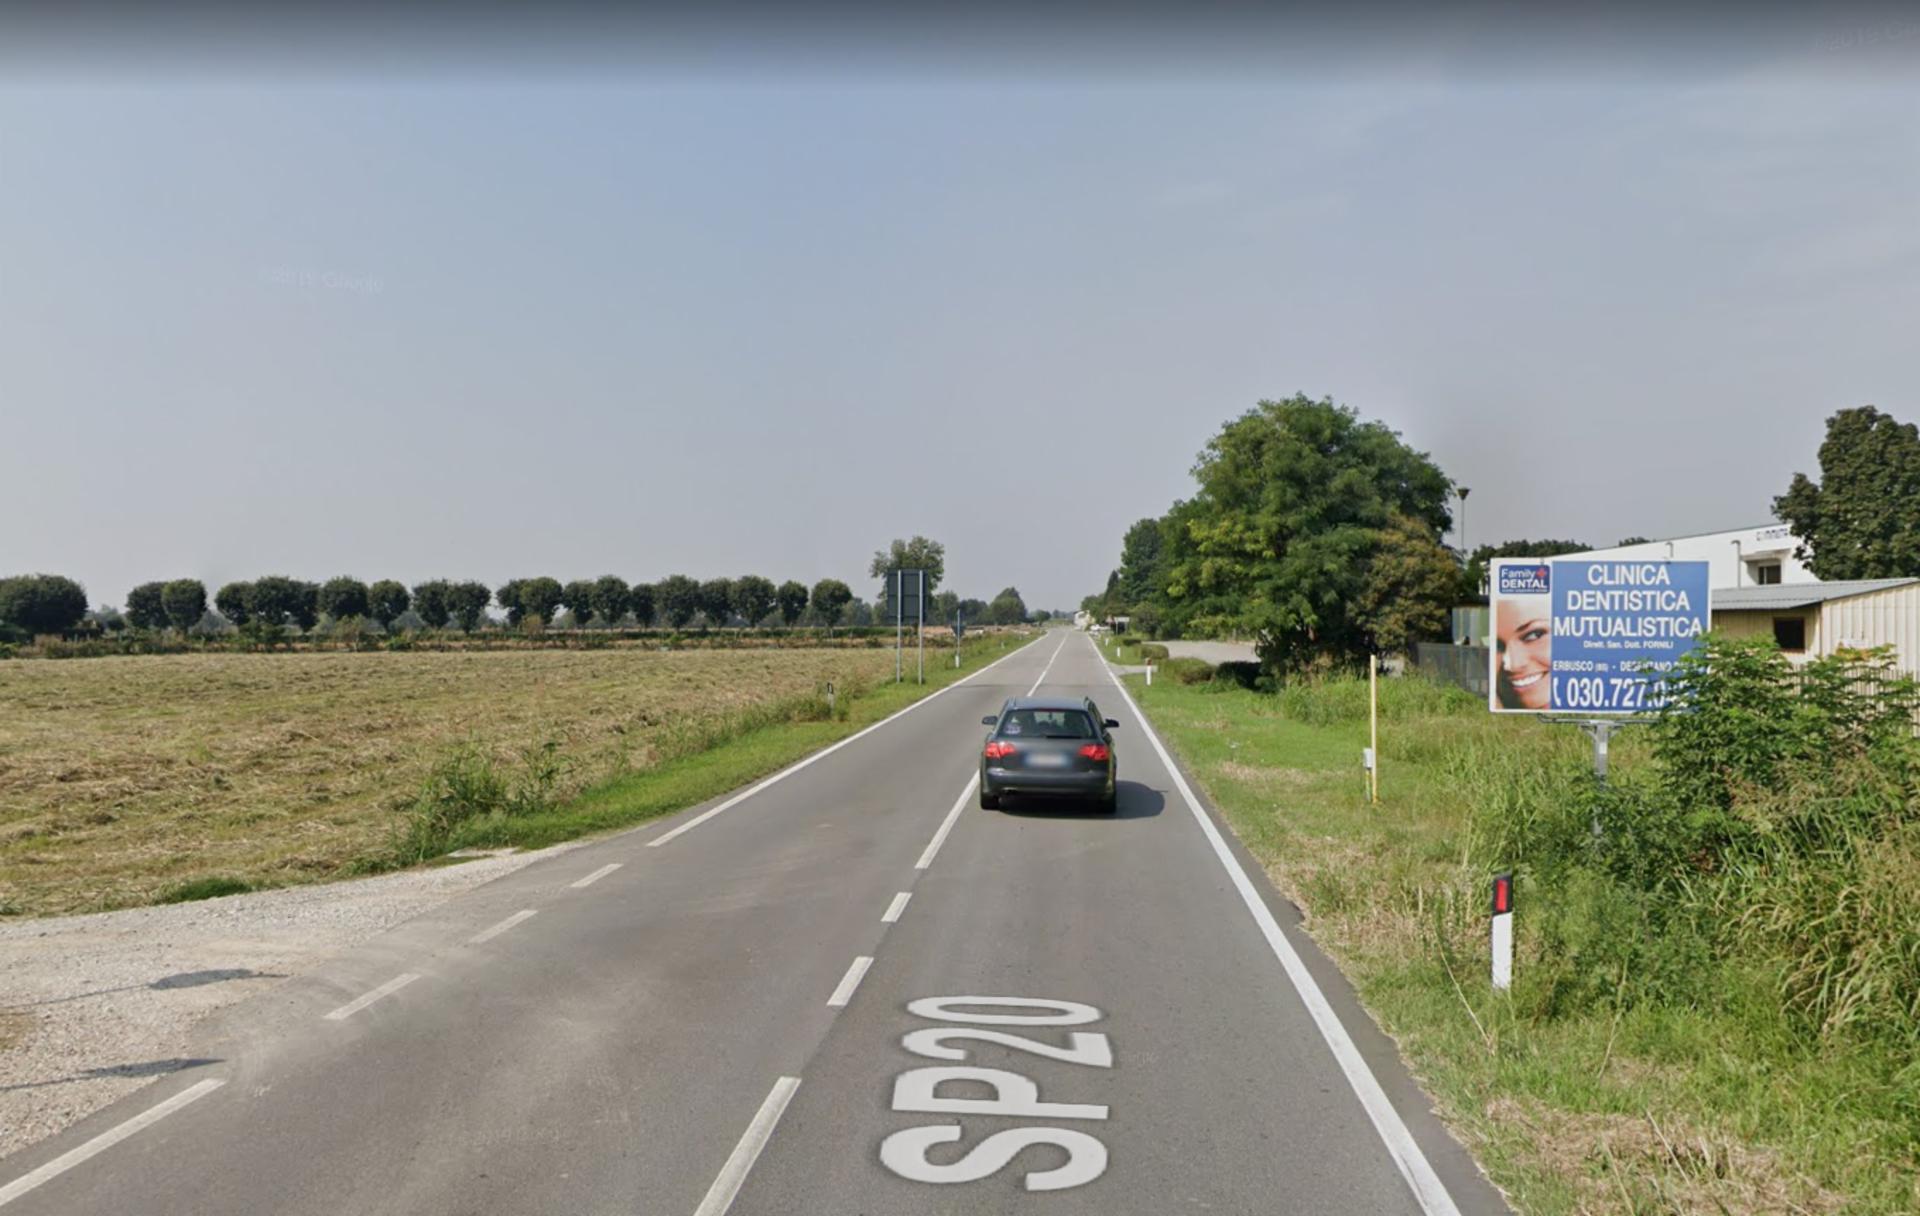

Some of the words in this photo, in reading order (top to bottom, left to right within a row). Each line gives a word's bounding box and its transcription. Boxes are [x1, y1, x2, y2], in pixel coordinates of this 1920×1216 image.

[1501, 568, 1536, 579] Family
[1501, 579, 1548, 589] DENTAL
[1587, 564, 1671, 586] CLINICA
[1567, 590, 1691, 611] DENTISTICA
[1553, 616, 1703, 638] MUTUALISTICA
[1553, 660, 1594, 672] ERBUSCO
[880, 995, 1113, 1192] SP20
